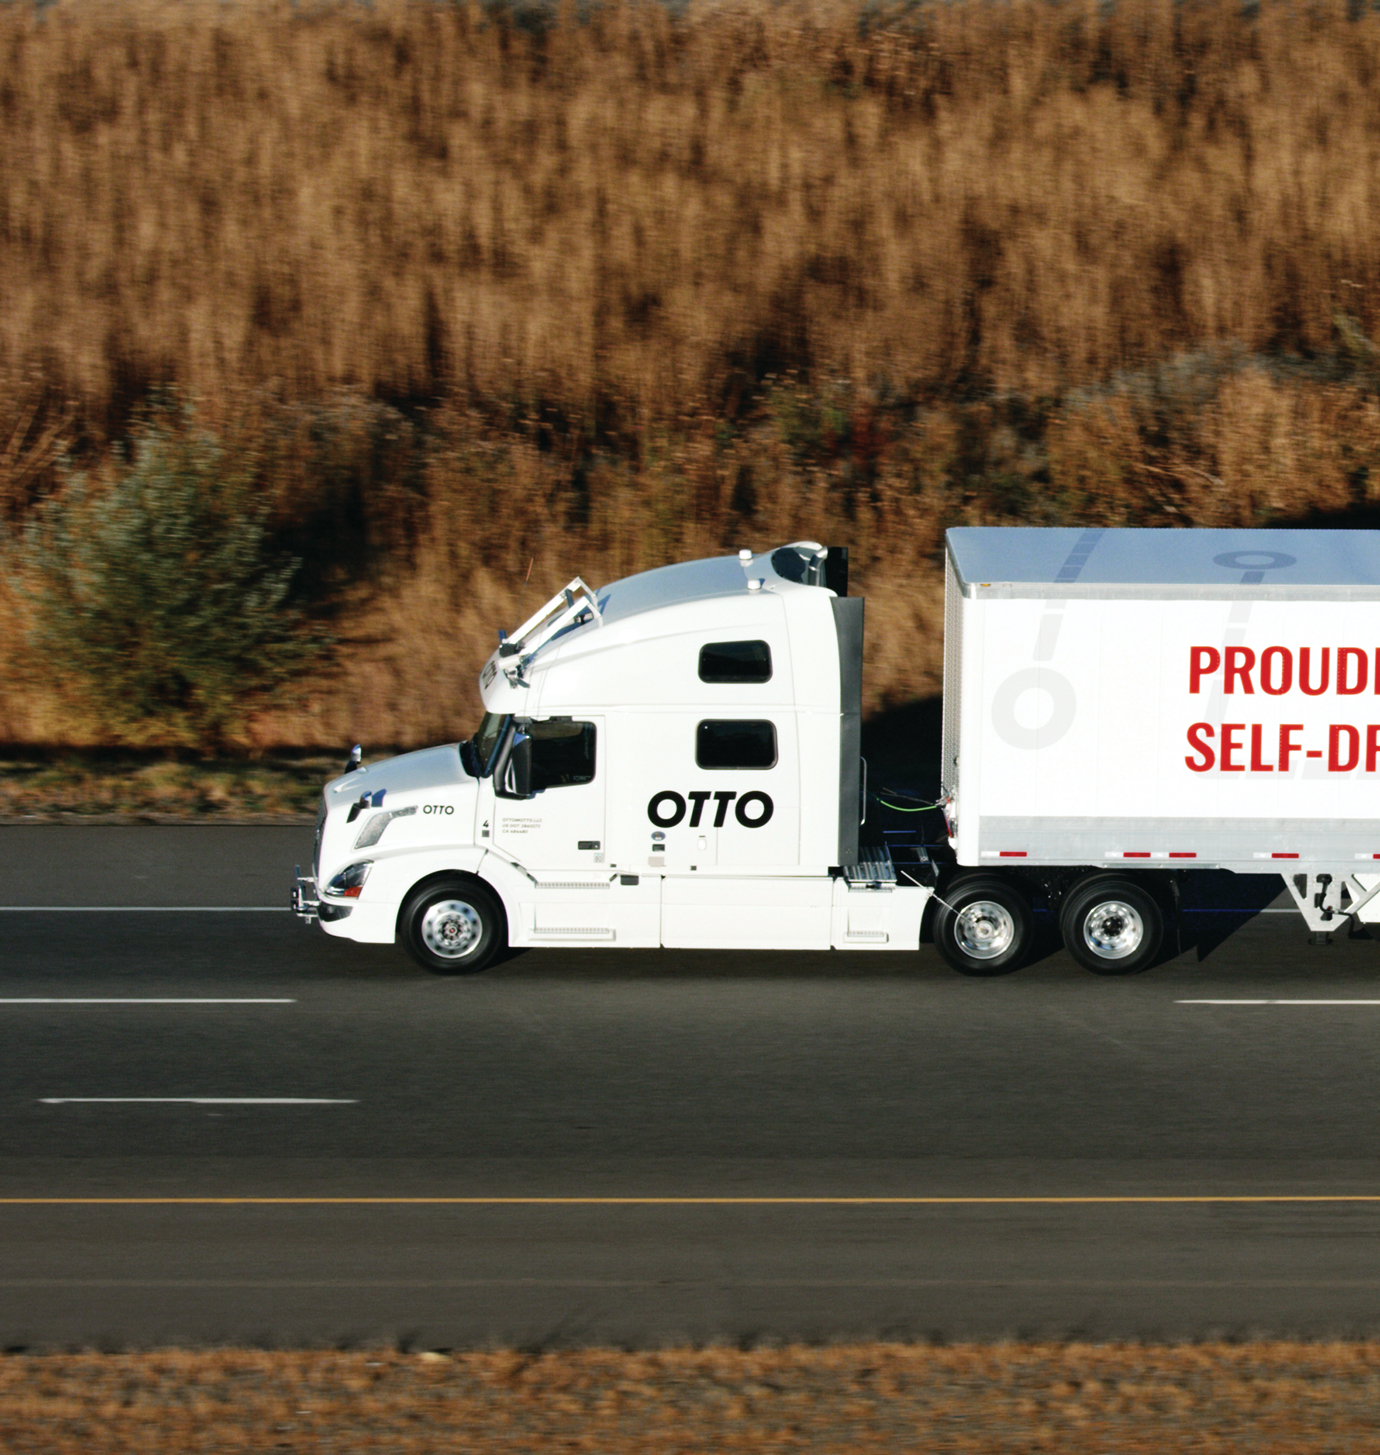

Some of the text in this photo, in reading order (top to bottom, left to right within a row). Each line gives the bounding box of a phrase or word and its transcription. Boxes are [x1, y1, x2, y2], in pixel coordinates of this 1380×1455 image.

[422, 804, 455, 815] OTTO
[647, 790, 774, 829] OTTO
[482, 820, 489, 828] 4
